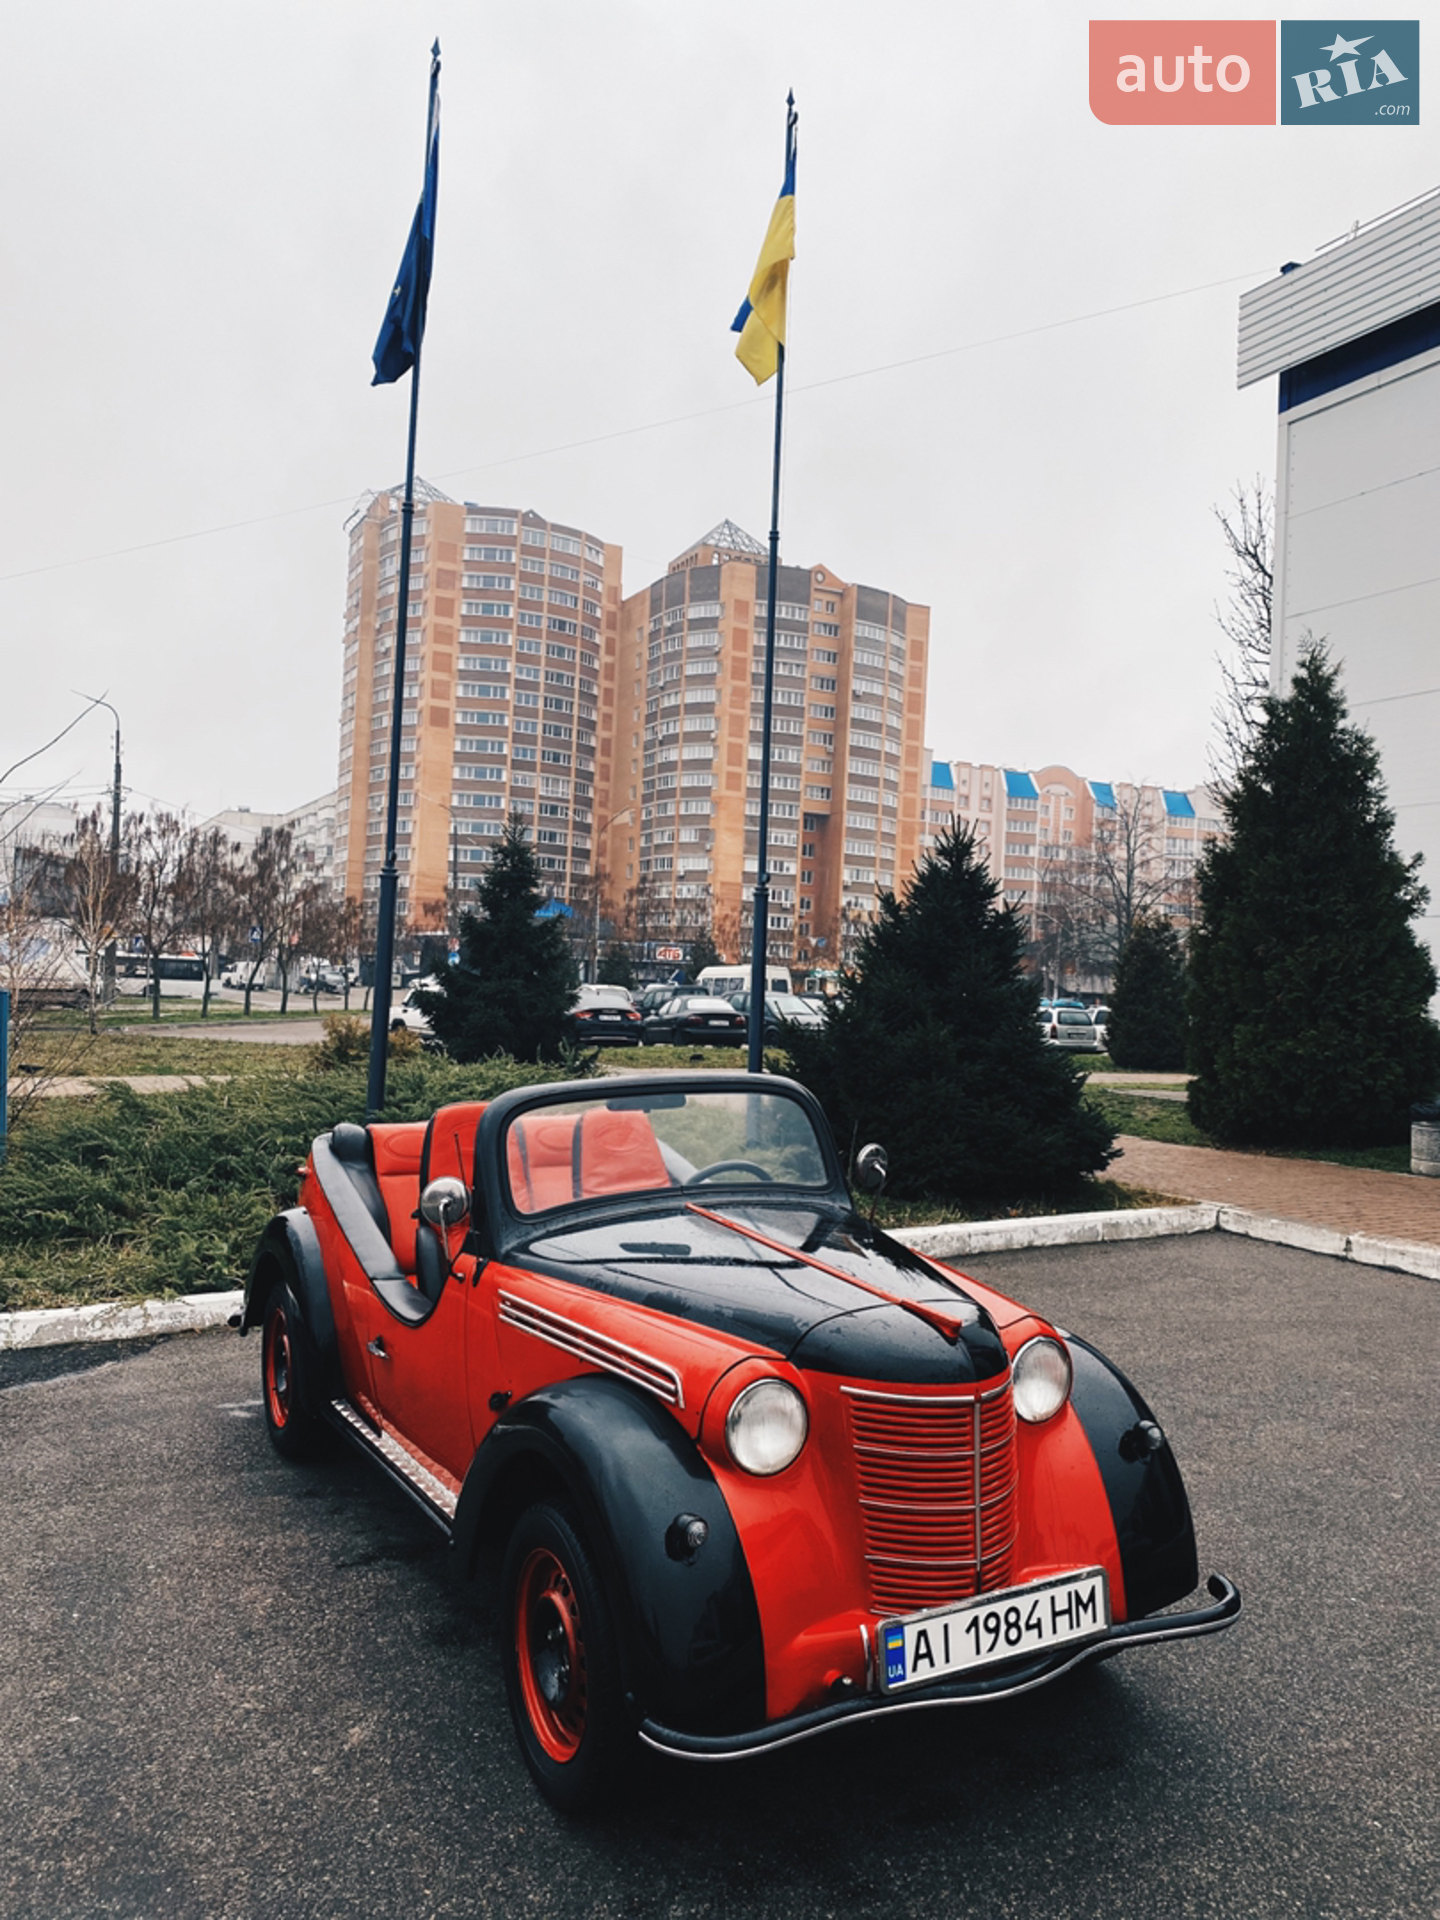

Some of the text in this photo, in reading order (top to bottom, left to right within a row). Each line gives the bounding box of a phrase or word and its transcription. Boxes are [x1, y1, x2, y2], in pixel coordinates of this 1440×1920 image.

[912, 1585, 1097, 1672] AI 1984 HM
[888, 1664, 904, 1678] UA
